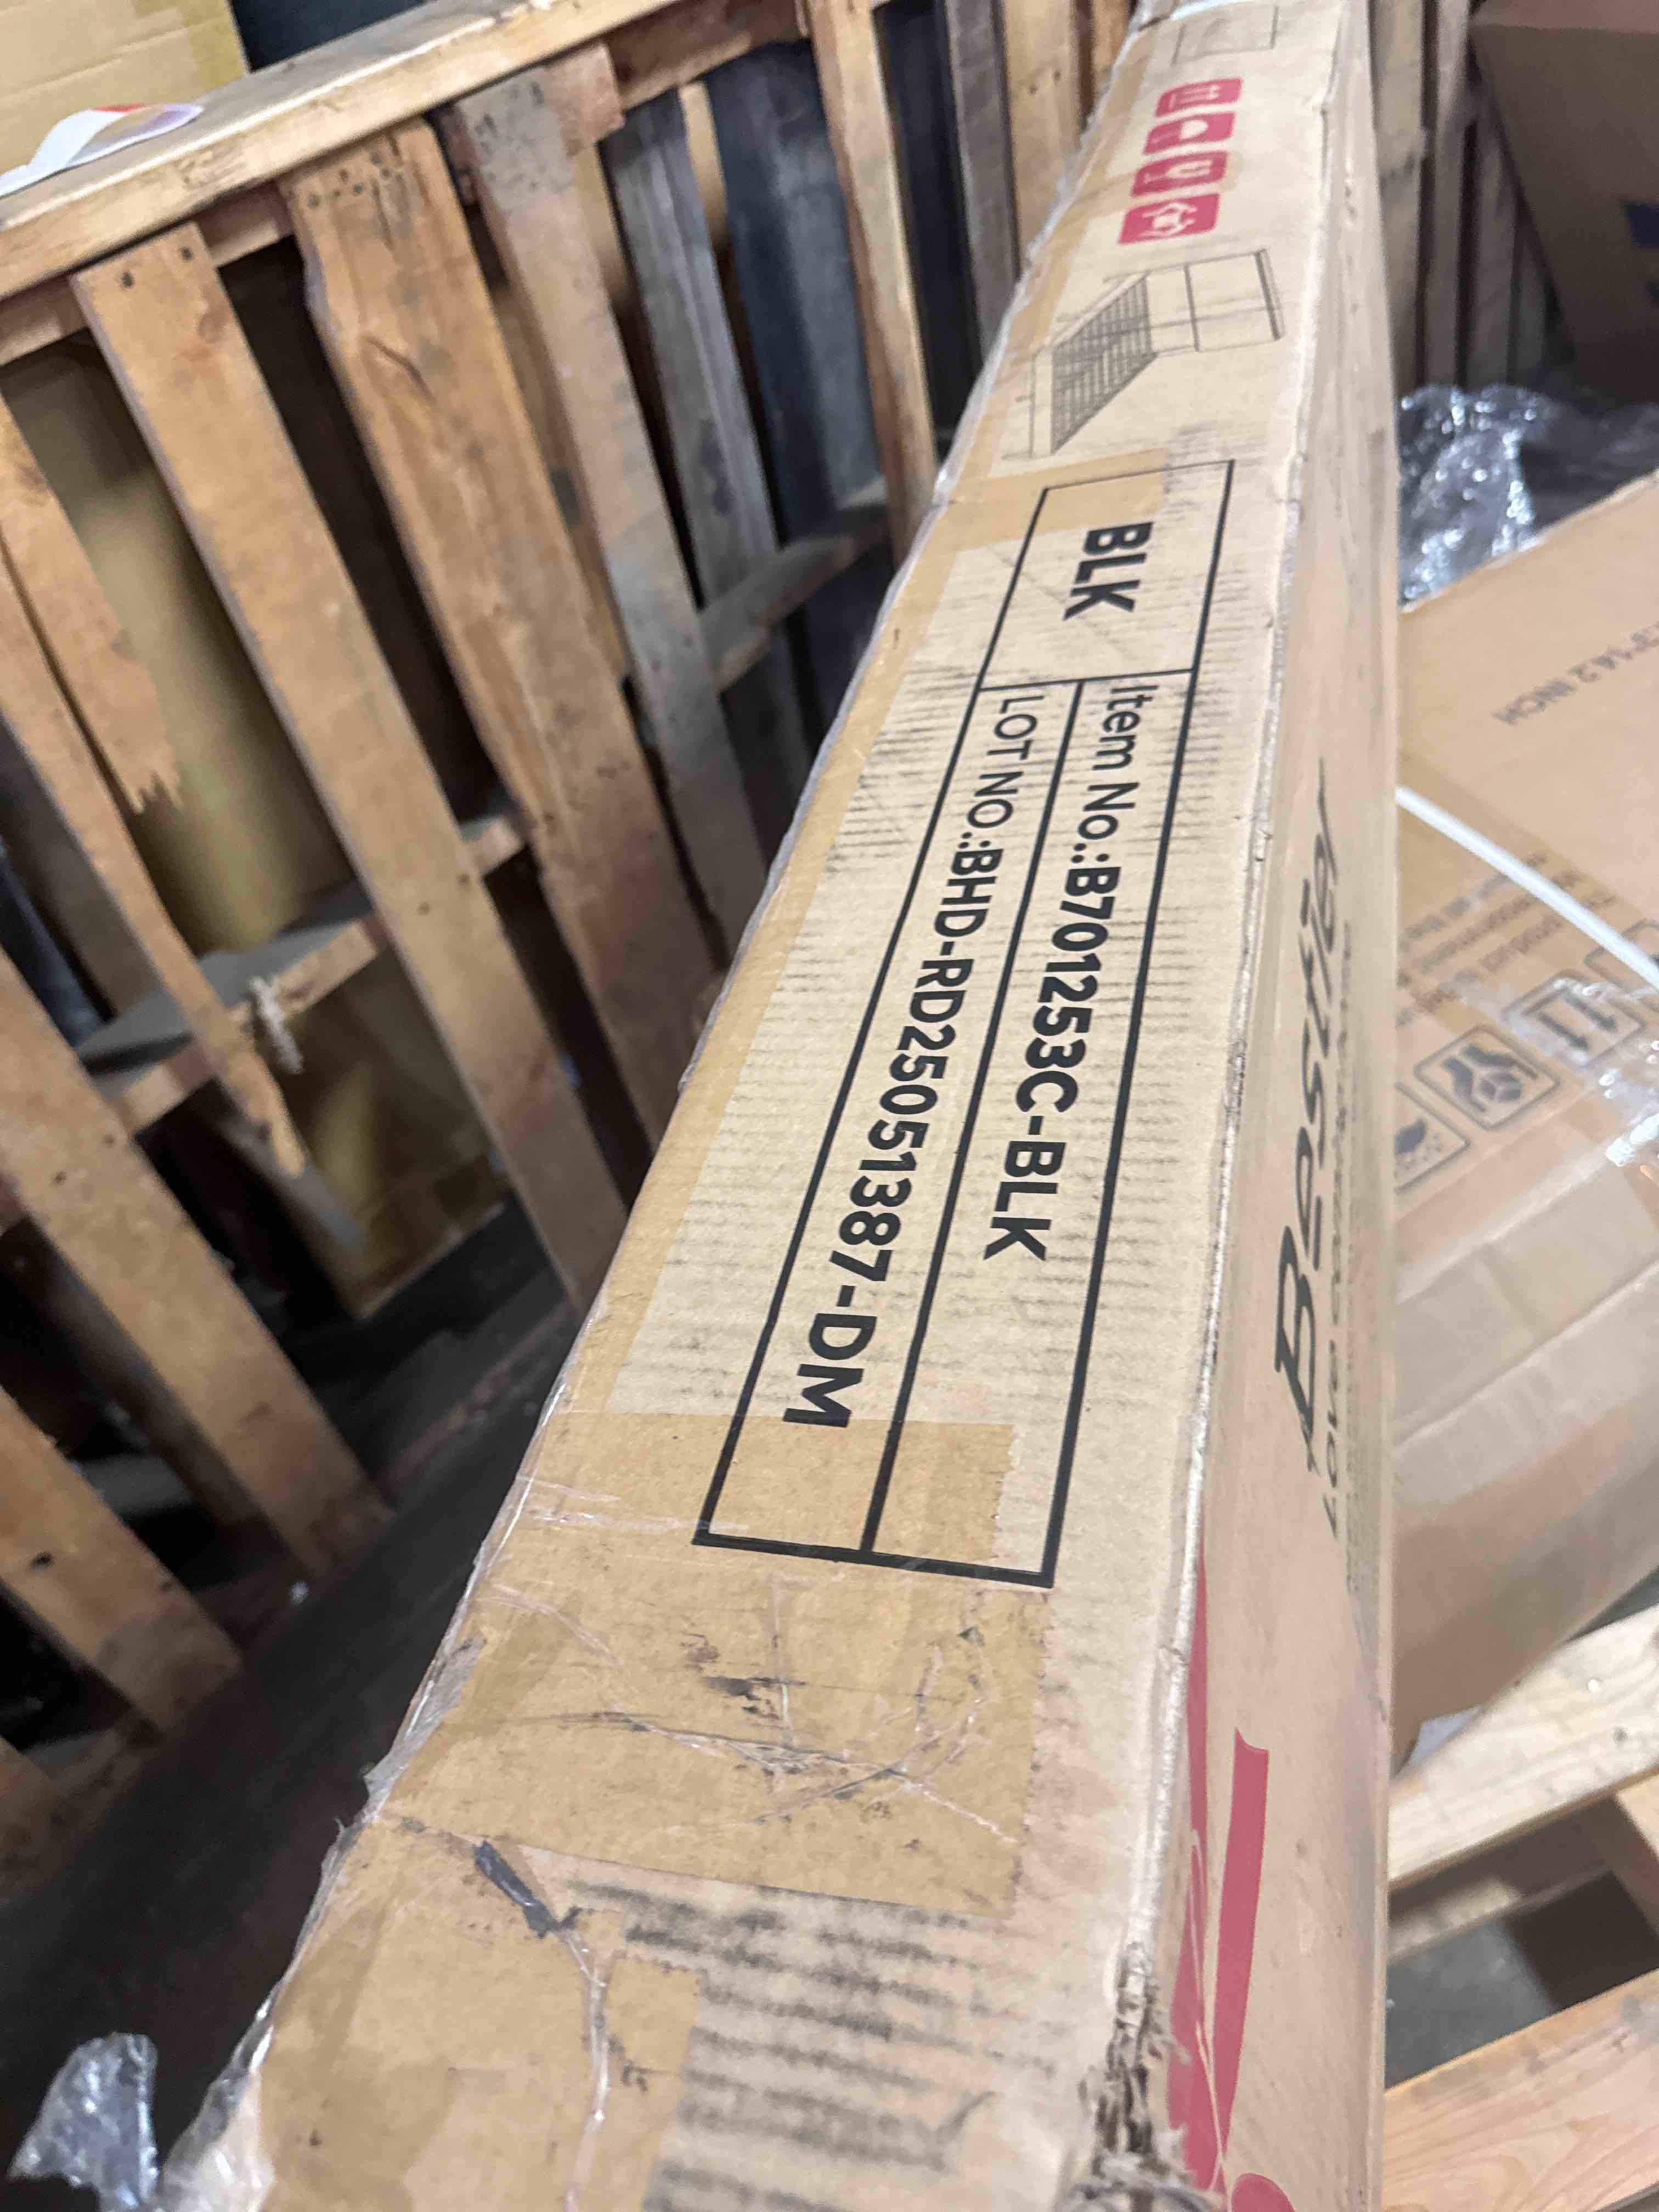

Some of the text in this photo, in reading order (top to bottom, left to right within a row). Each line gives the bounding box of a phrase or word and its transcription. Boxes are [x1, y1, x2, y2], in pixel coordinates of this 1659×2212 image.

[1063, 521, 1154, 621] BLK
[986, 695, 1045, 761] LOT
[1092, 684, 1159, 771] Item
